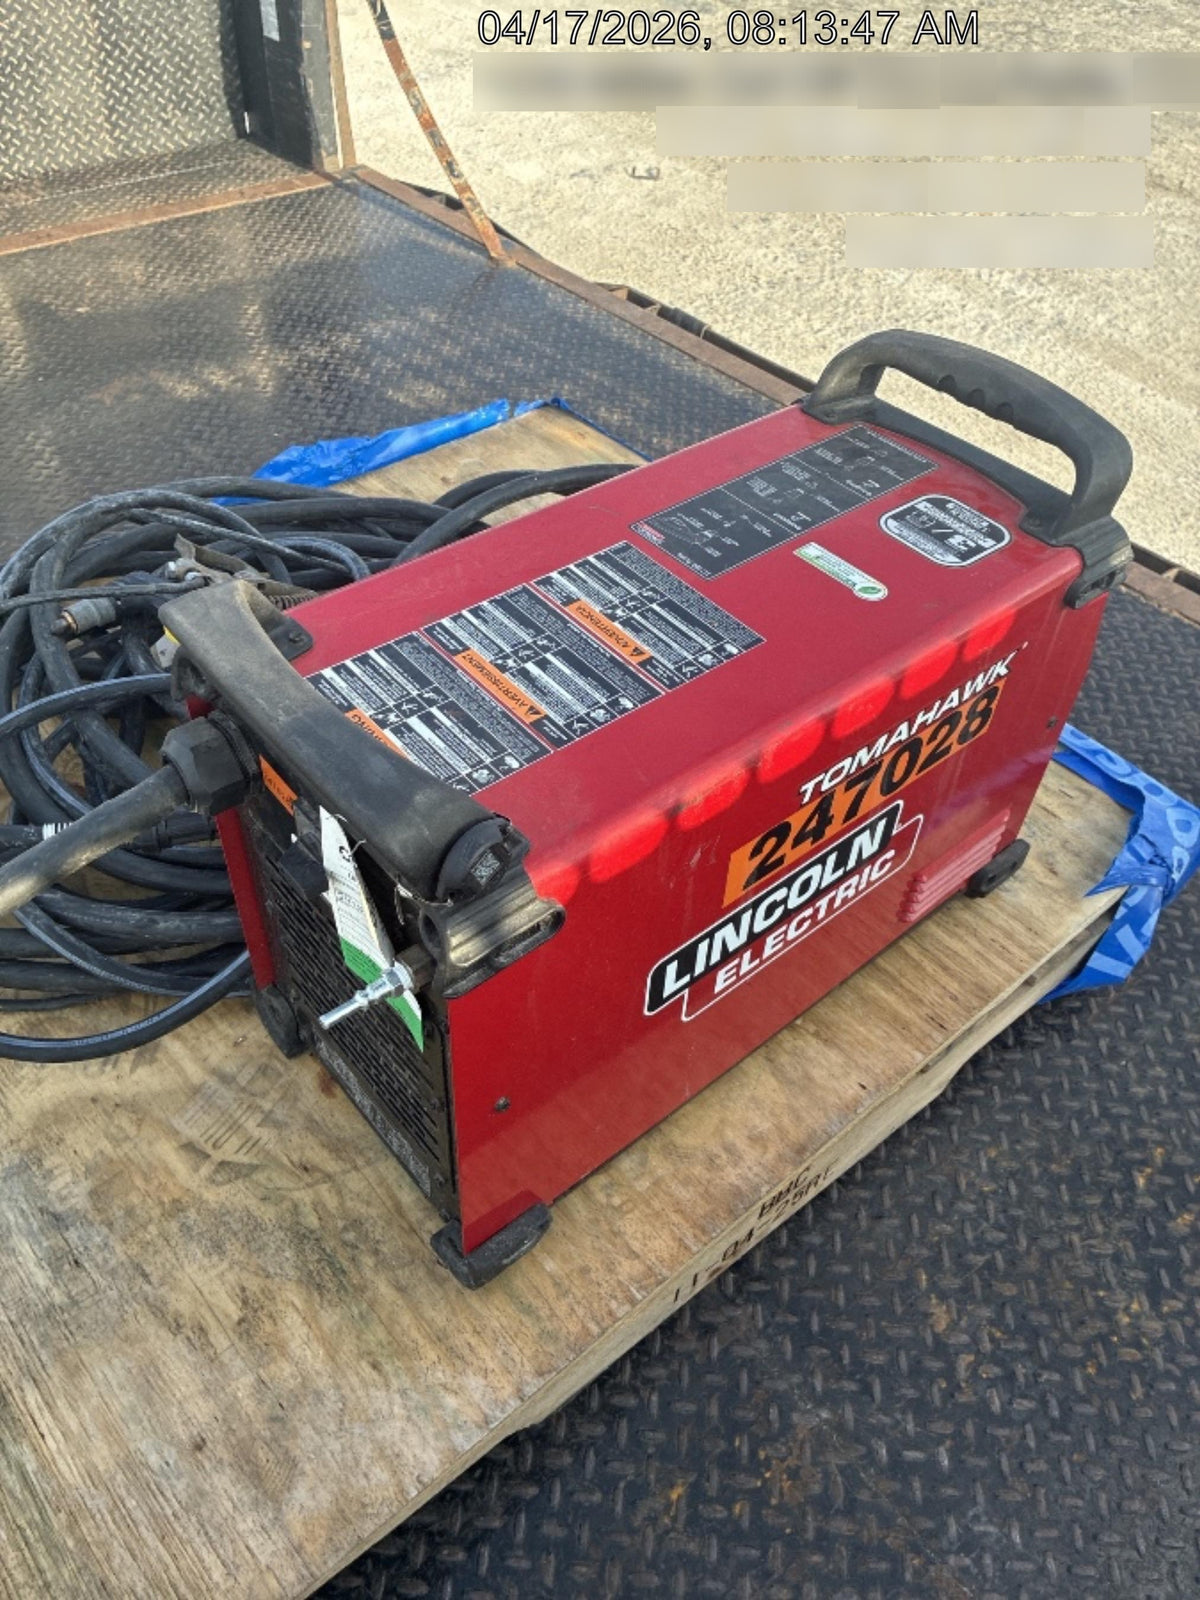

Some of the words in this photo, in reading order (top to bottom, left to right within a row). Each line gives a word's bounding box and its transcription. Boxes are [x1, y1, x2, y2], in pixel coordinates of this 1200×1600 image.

[742, 685, 1001, 892] 247028
[800, 648, 1018, 804] TOMAHAWK
[662, 816, 888, 998] LINCOLN
[714, 849, 897, 994] ELECTRIC
